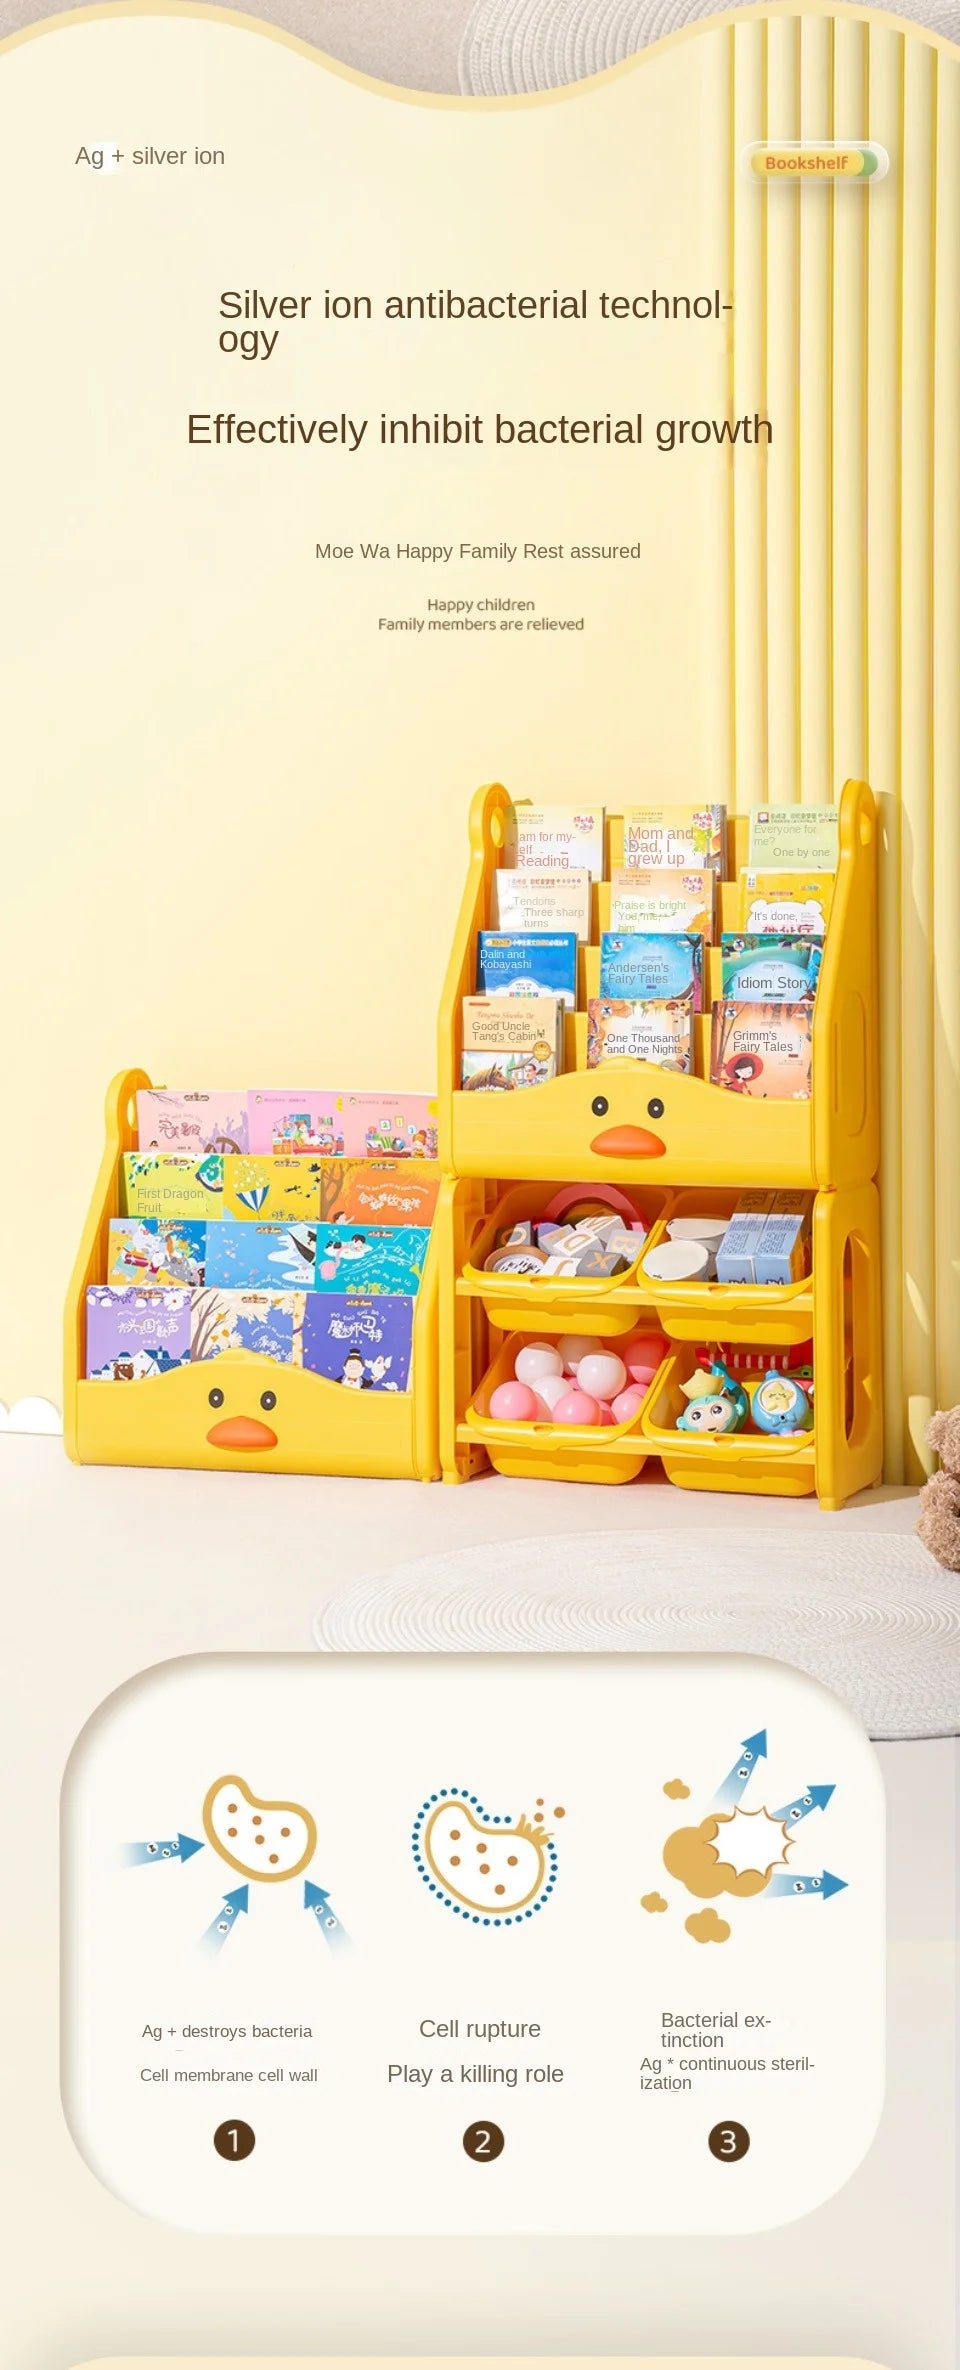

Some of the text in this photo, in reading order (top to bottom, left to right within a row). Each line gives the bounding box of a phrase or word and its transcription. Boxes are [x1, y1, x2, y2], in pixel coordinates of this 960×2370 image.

[628, 827, 694, 840] Mom and
[754, 825, 816, 835] Everyone for
[520, 833, 536, 842] am
[540, 832, 553, 842] for
[754, 837, 776, 846] me?
[773, 848, 794, 857] One
[797, 848, 808, 858] by
[516, 855, 569, 869] Reading
[628, 854, 685, 868] grew up
[512, 897, 556, 906] Tendons
[614, 901, 687, 912] Praise is bright
[523, 908, 585, 919] Three sharp
[754, 912, 768, 921] It's
[771, 912, 799, 922] done,
[524, 920, 549, 928] turns
[480, 950, 526, 959] Dalin and
[480, 960, 532, 971] Kobayashi
[608, 963, 670, 973] Andersen's
[608, 974, 668, 985] Fairy Tales
[737, 977, 811, 992] Idiom Story
[472, 1022, 530, 1031] Good Uncle
[473, 1032, 505, 1043] Tang's
[508, 1032, 537, 1041] Cabin
[607, 1034, 681, 1043] One Thousand
[733, 1031, 778, 1041] Grimm's
[607, 1045, 683, 1056] and One Nights
[733, 1042, 794, 1053] Fairy Tales
[137, 1189, 204, 1200] First Dragon
[137, 1203, 162, 1213] Fruit
